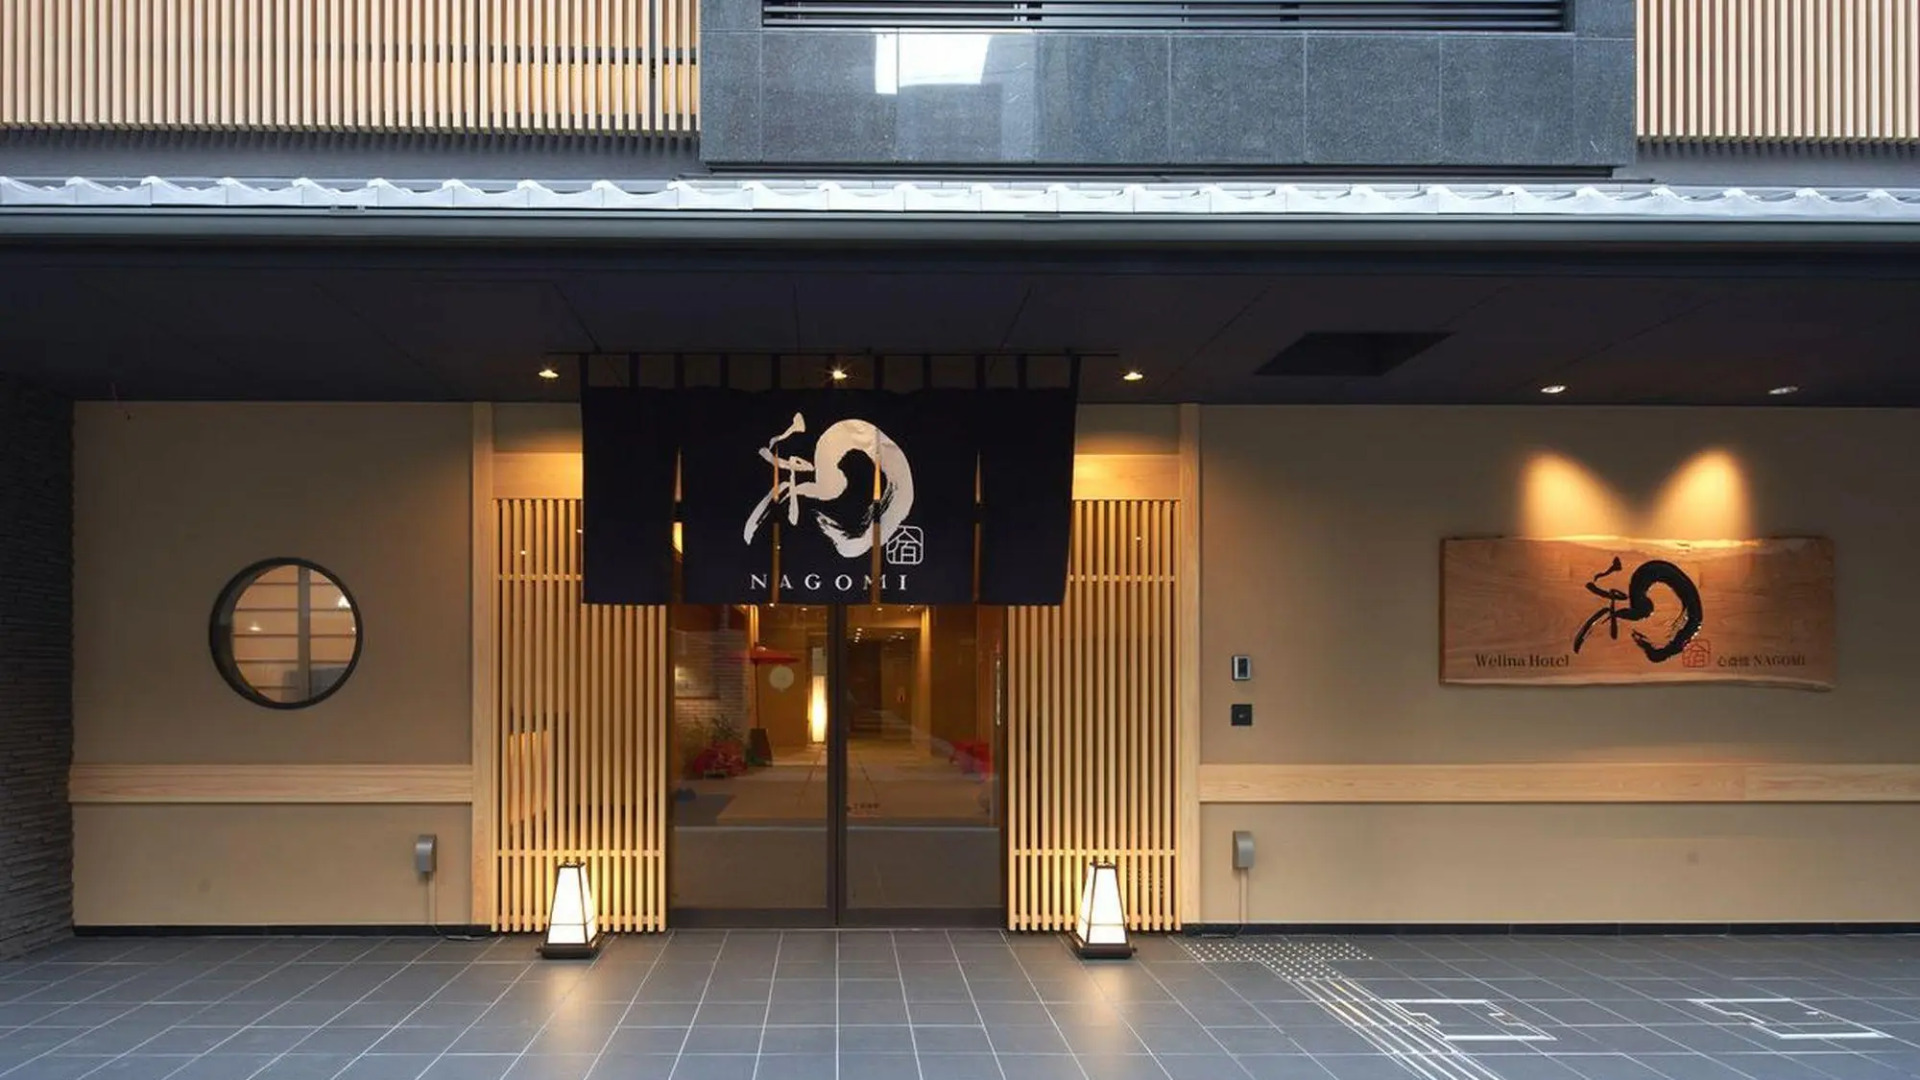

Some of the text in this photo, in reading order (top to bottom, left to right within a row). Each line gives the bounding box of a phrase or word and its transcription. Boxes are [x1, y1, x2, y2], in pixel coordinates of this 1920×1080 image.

[750, 573, 908, 591] NAGOMI
[1475, 654, 1569, 668] Welina Hotel
